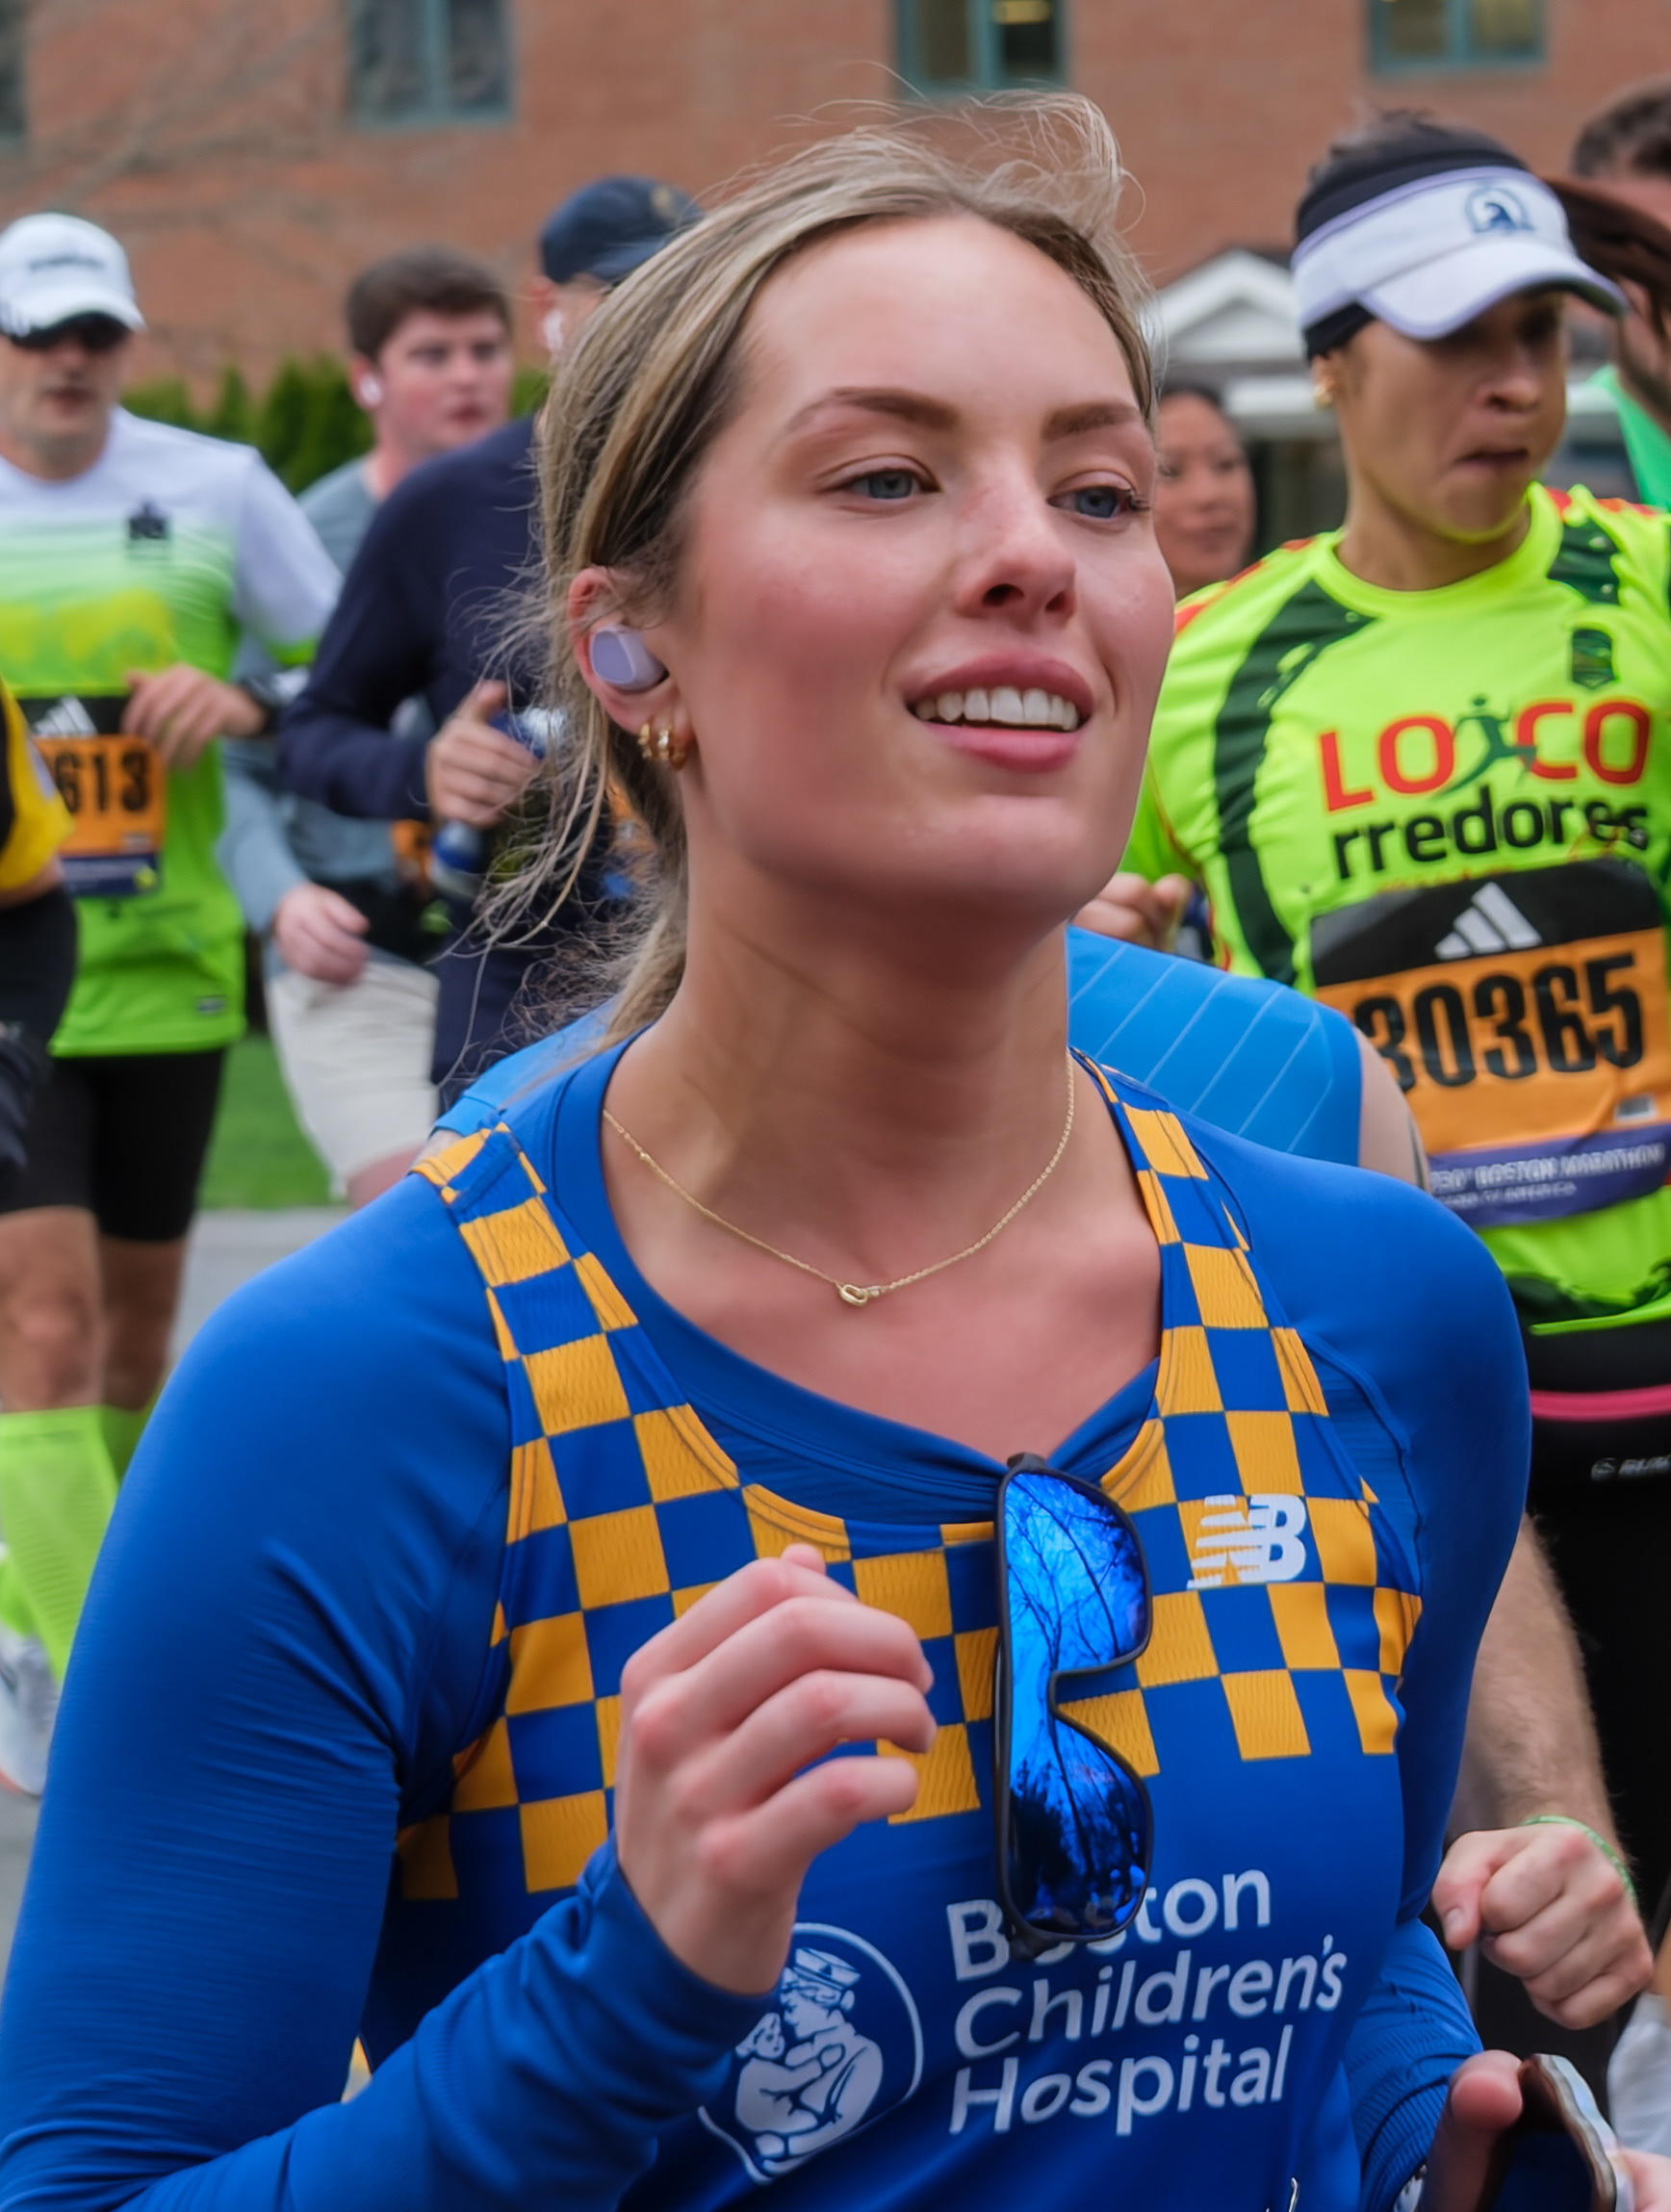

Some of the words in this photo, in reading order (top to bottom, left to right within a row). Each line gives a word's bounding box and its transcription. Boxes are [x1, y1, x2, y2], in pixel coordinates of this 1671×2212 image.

[1331, 784, 1649, 881] rredores
[1352, 951, 1646, 1095] 30365
[946, 1868, 1271, 1981] Bton
[954, 1935, 1348, 2059] Children's
[949, 2024, 1293, 2137] Hospital
